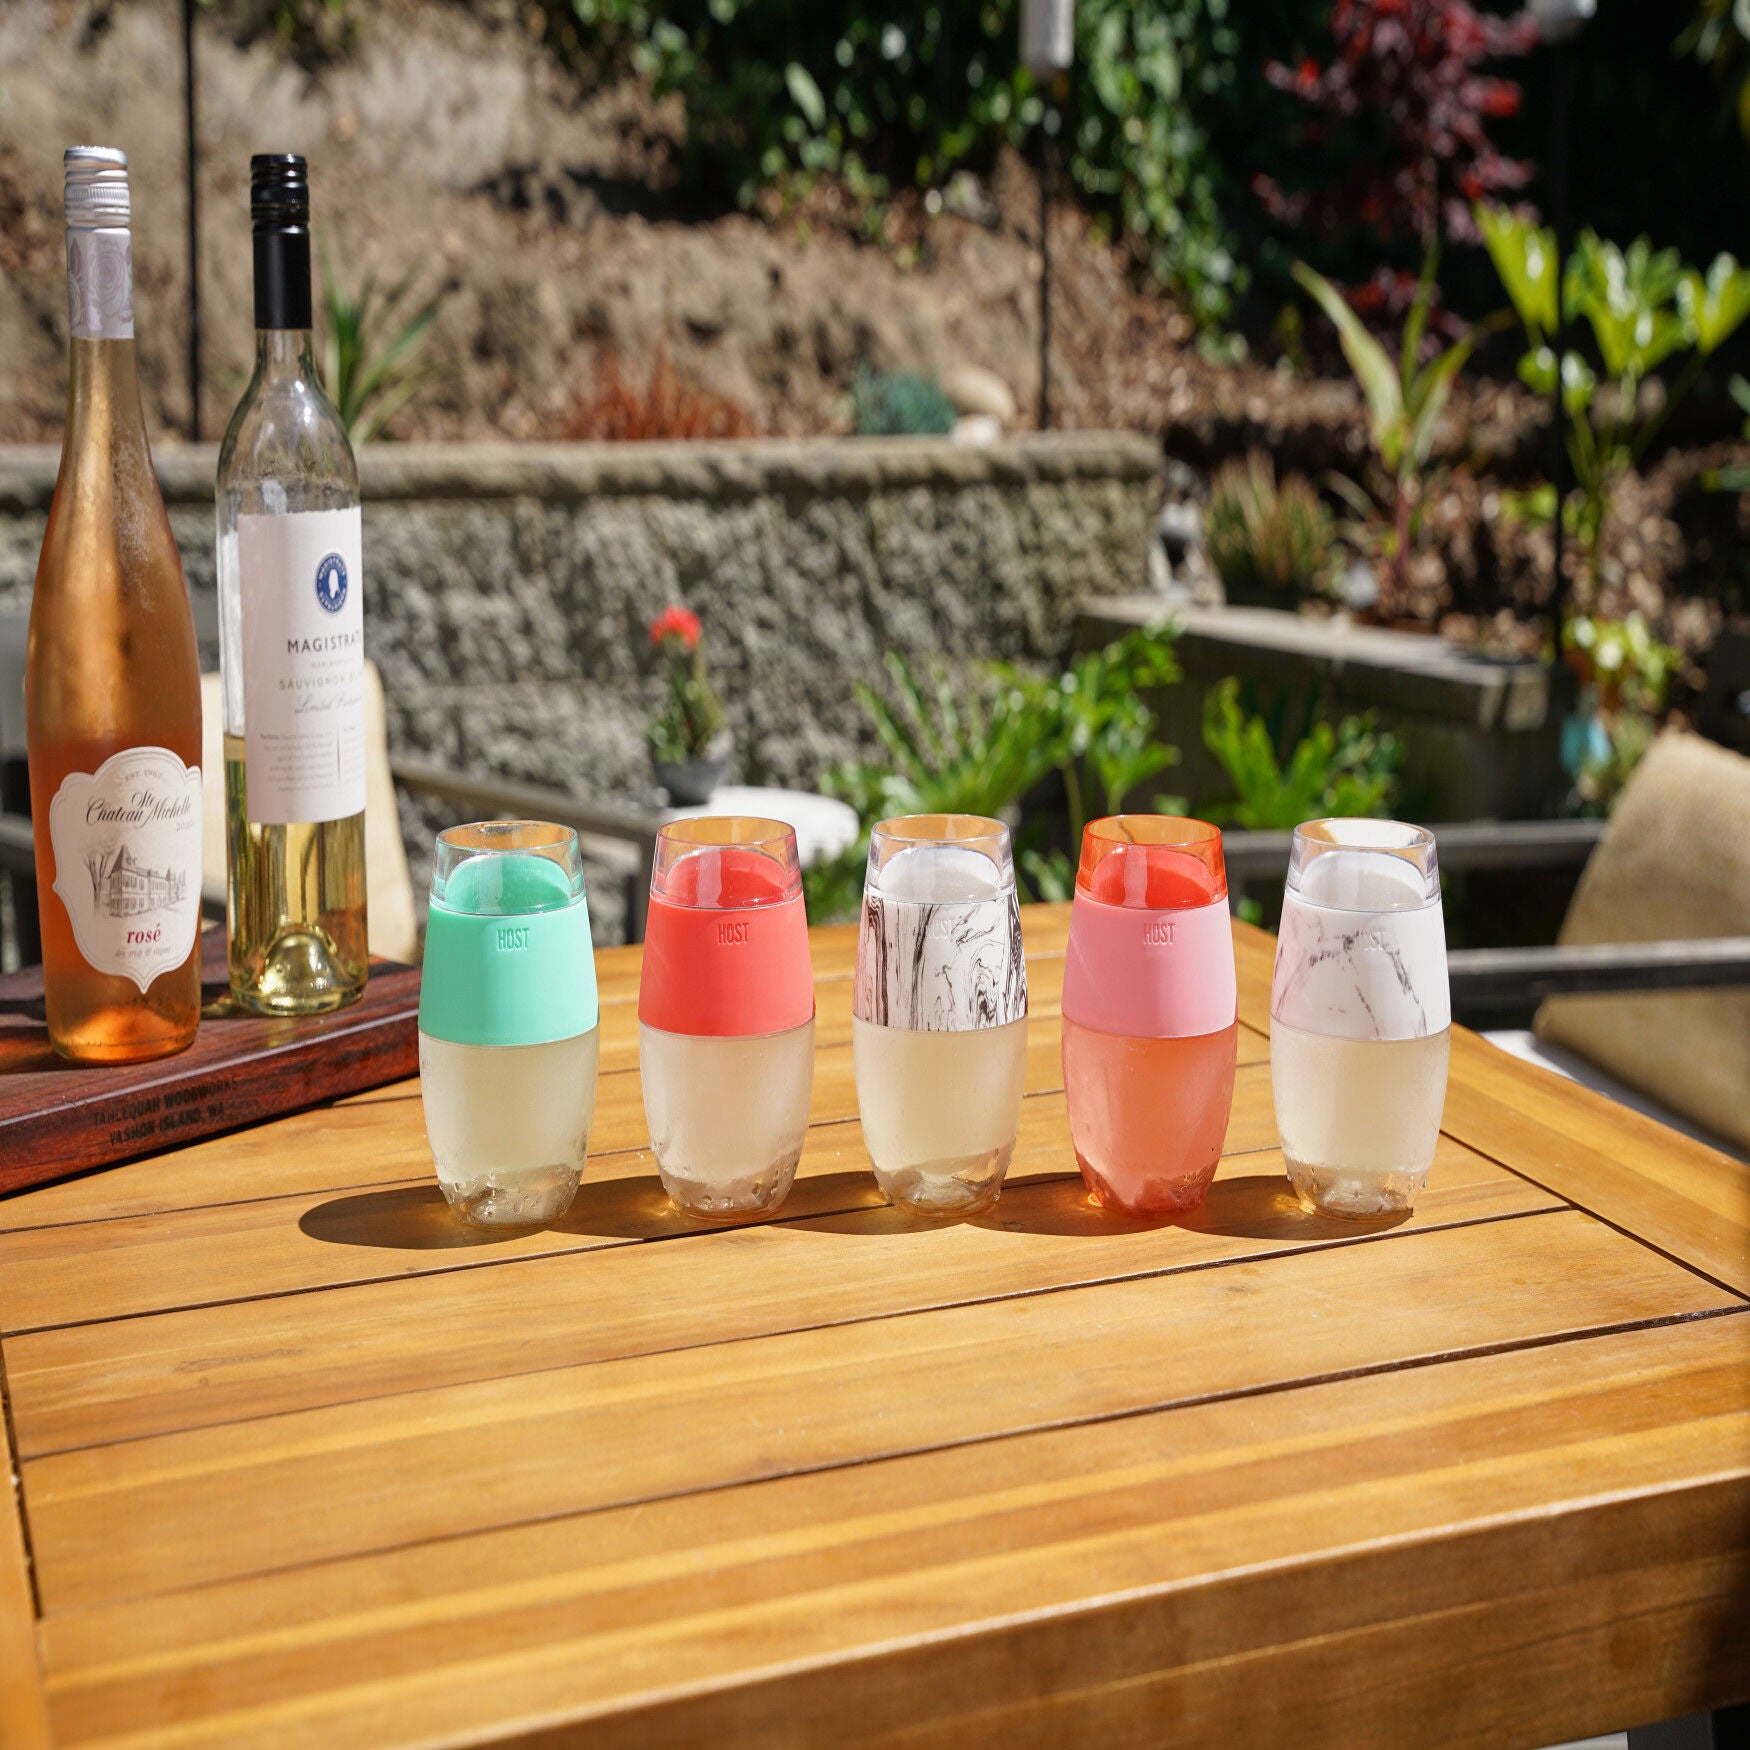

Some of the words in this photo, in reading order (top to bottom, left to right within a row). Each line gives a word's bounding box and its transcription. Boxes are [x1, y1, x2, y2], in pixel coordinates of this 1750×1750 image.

[86, 795, 144, 826] Chateau
[127, 923, 161, 944] rosé
[497, 927, 529, 951] HOST
[718, 922, 749, 945] HOST
[1143, 922, 1175, 945] HOST
[94, 1096, 160, 1126] TAHLEQUAH
[164, 1077, 238, 1109] WOODWORKS
[110, 1119, 155, 1146] VASHON
[207, 1102, 225, 1120] WA
